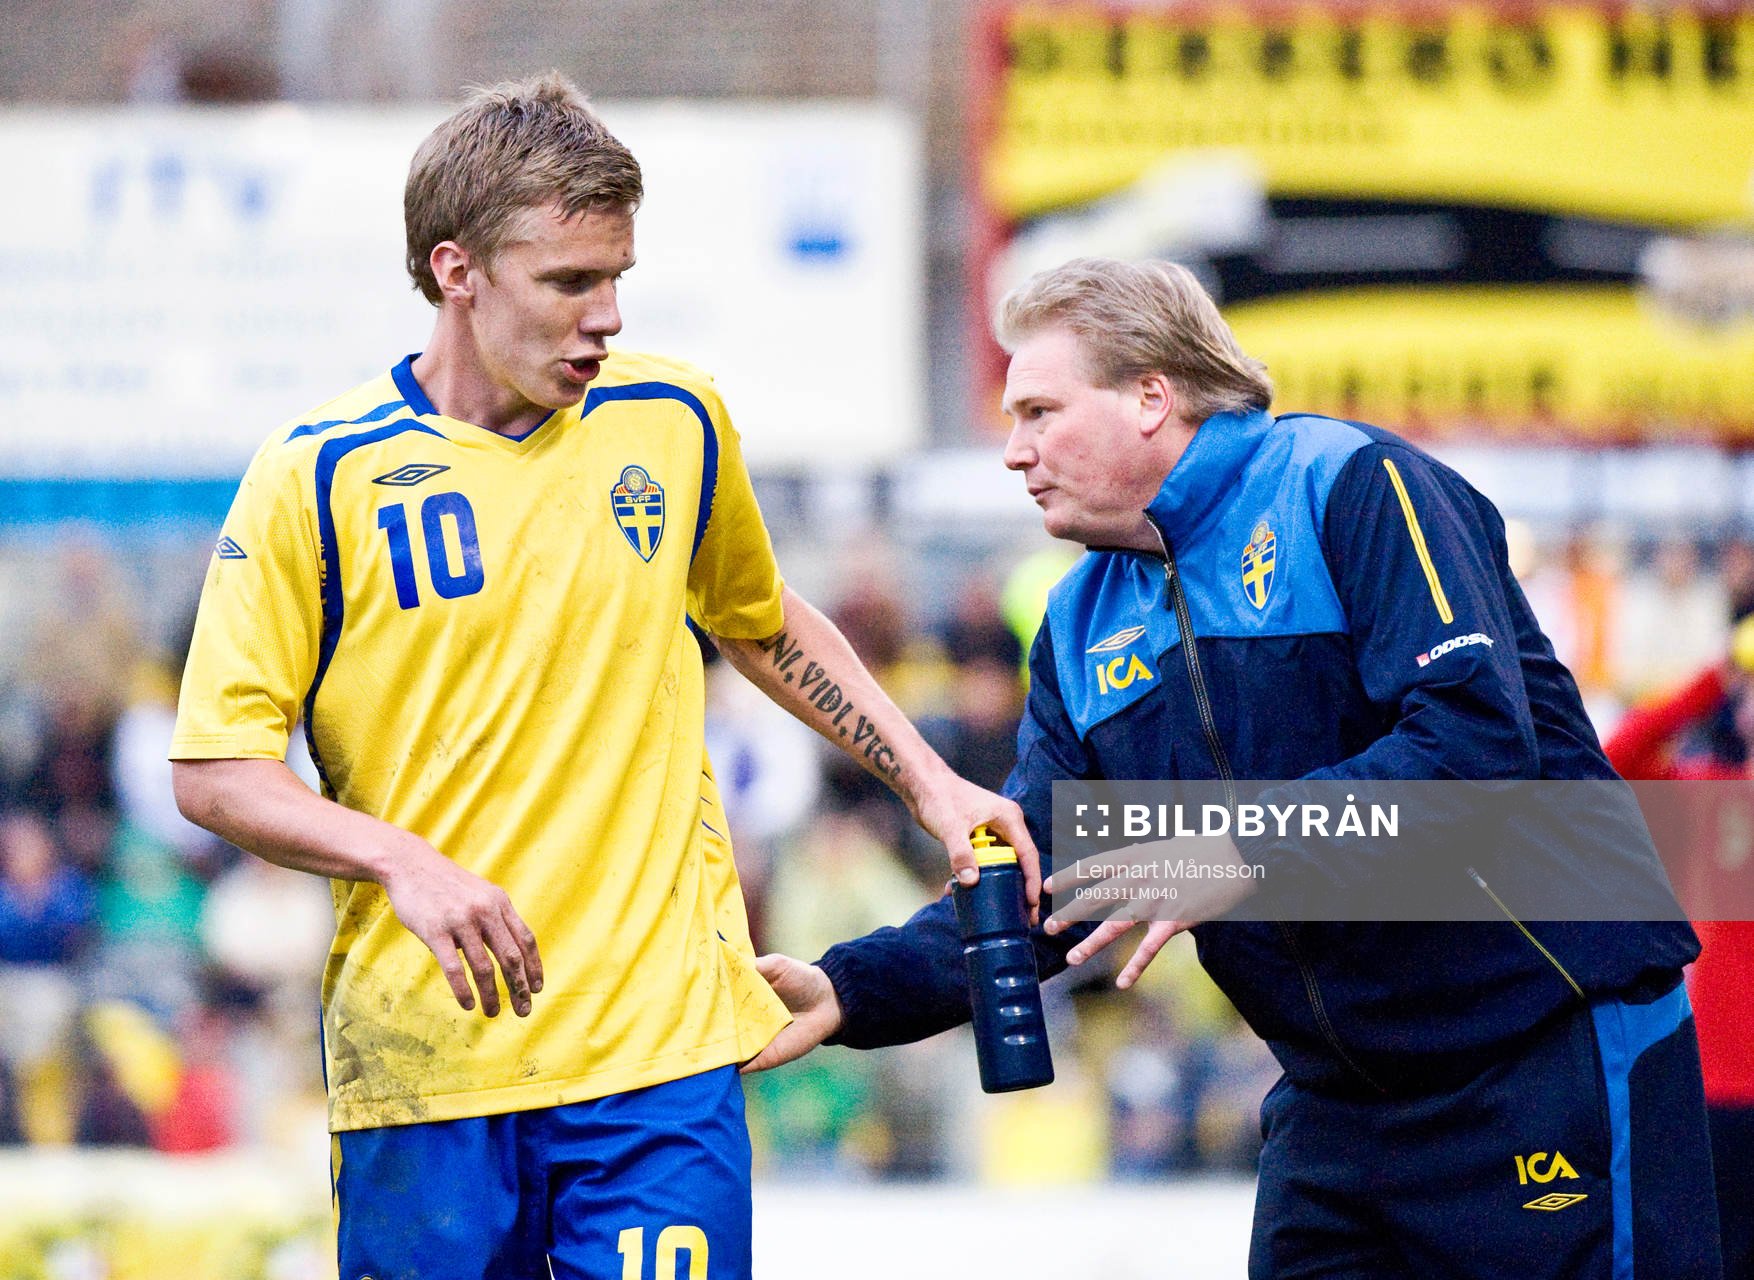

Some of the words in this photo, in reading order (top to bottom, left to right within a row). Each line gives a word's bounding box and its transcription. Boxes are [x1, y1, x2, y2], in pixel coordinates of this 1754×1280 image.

[625, 495, 651, 504] SvFF
[377, 491, 485, 610] 10
[1096, 653, 1154, 695] ICA
[1514, 1150, 1580, 1185] ICA
[617, 1225, 709, 1280] 10
